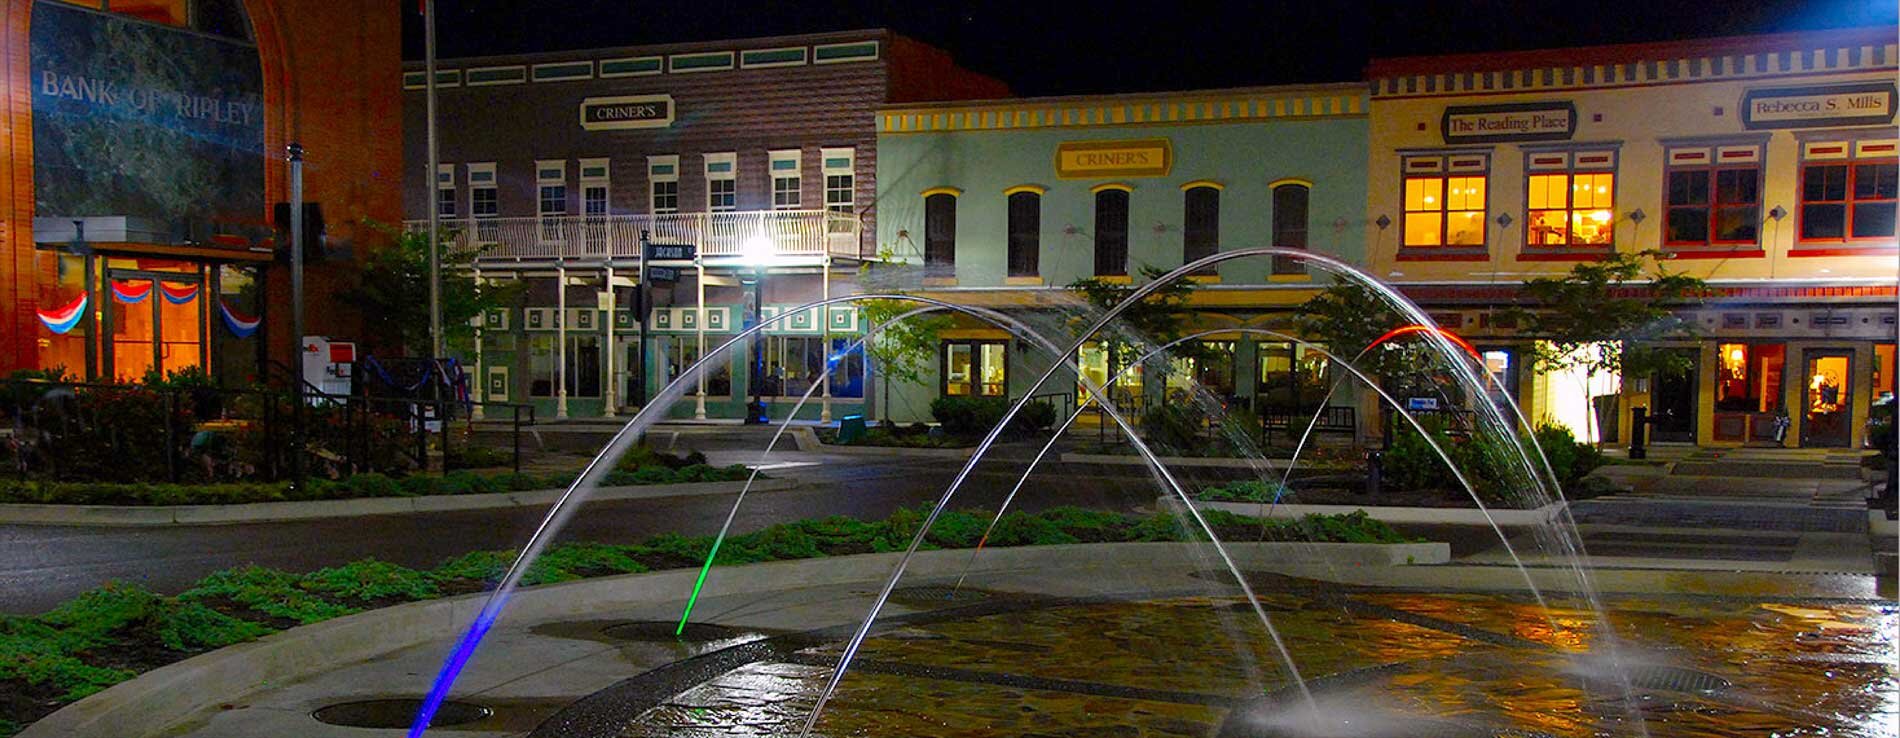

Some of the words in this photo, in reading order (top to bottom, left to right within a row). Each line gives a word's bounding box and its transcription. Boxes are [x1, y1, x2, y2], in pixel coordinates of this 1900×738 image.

[42, 70, 113, 105] BANK
[129, 87, 163, 110] OF
[177, 94, 257, 125] RIPLEY
[1756, 101, 1820, 114] Rebecca
[1825, 98, 1841, 110] S.
[1847, 95, 1882, 110] Mills
[597, 105, 656, 119] CRINER'S
[1451, 118, 1473, 132] The
[1477, 115, 1529, 132] Reading
[1532, 114, 1566, 129] Place
[1076, 152, 1149, 166] CRINER'S
